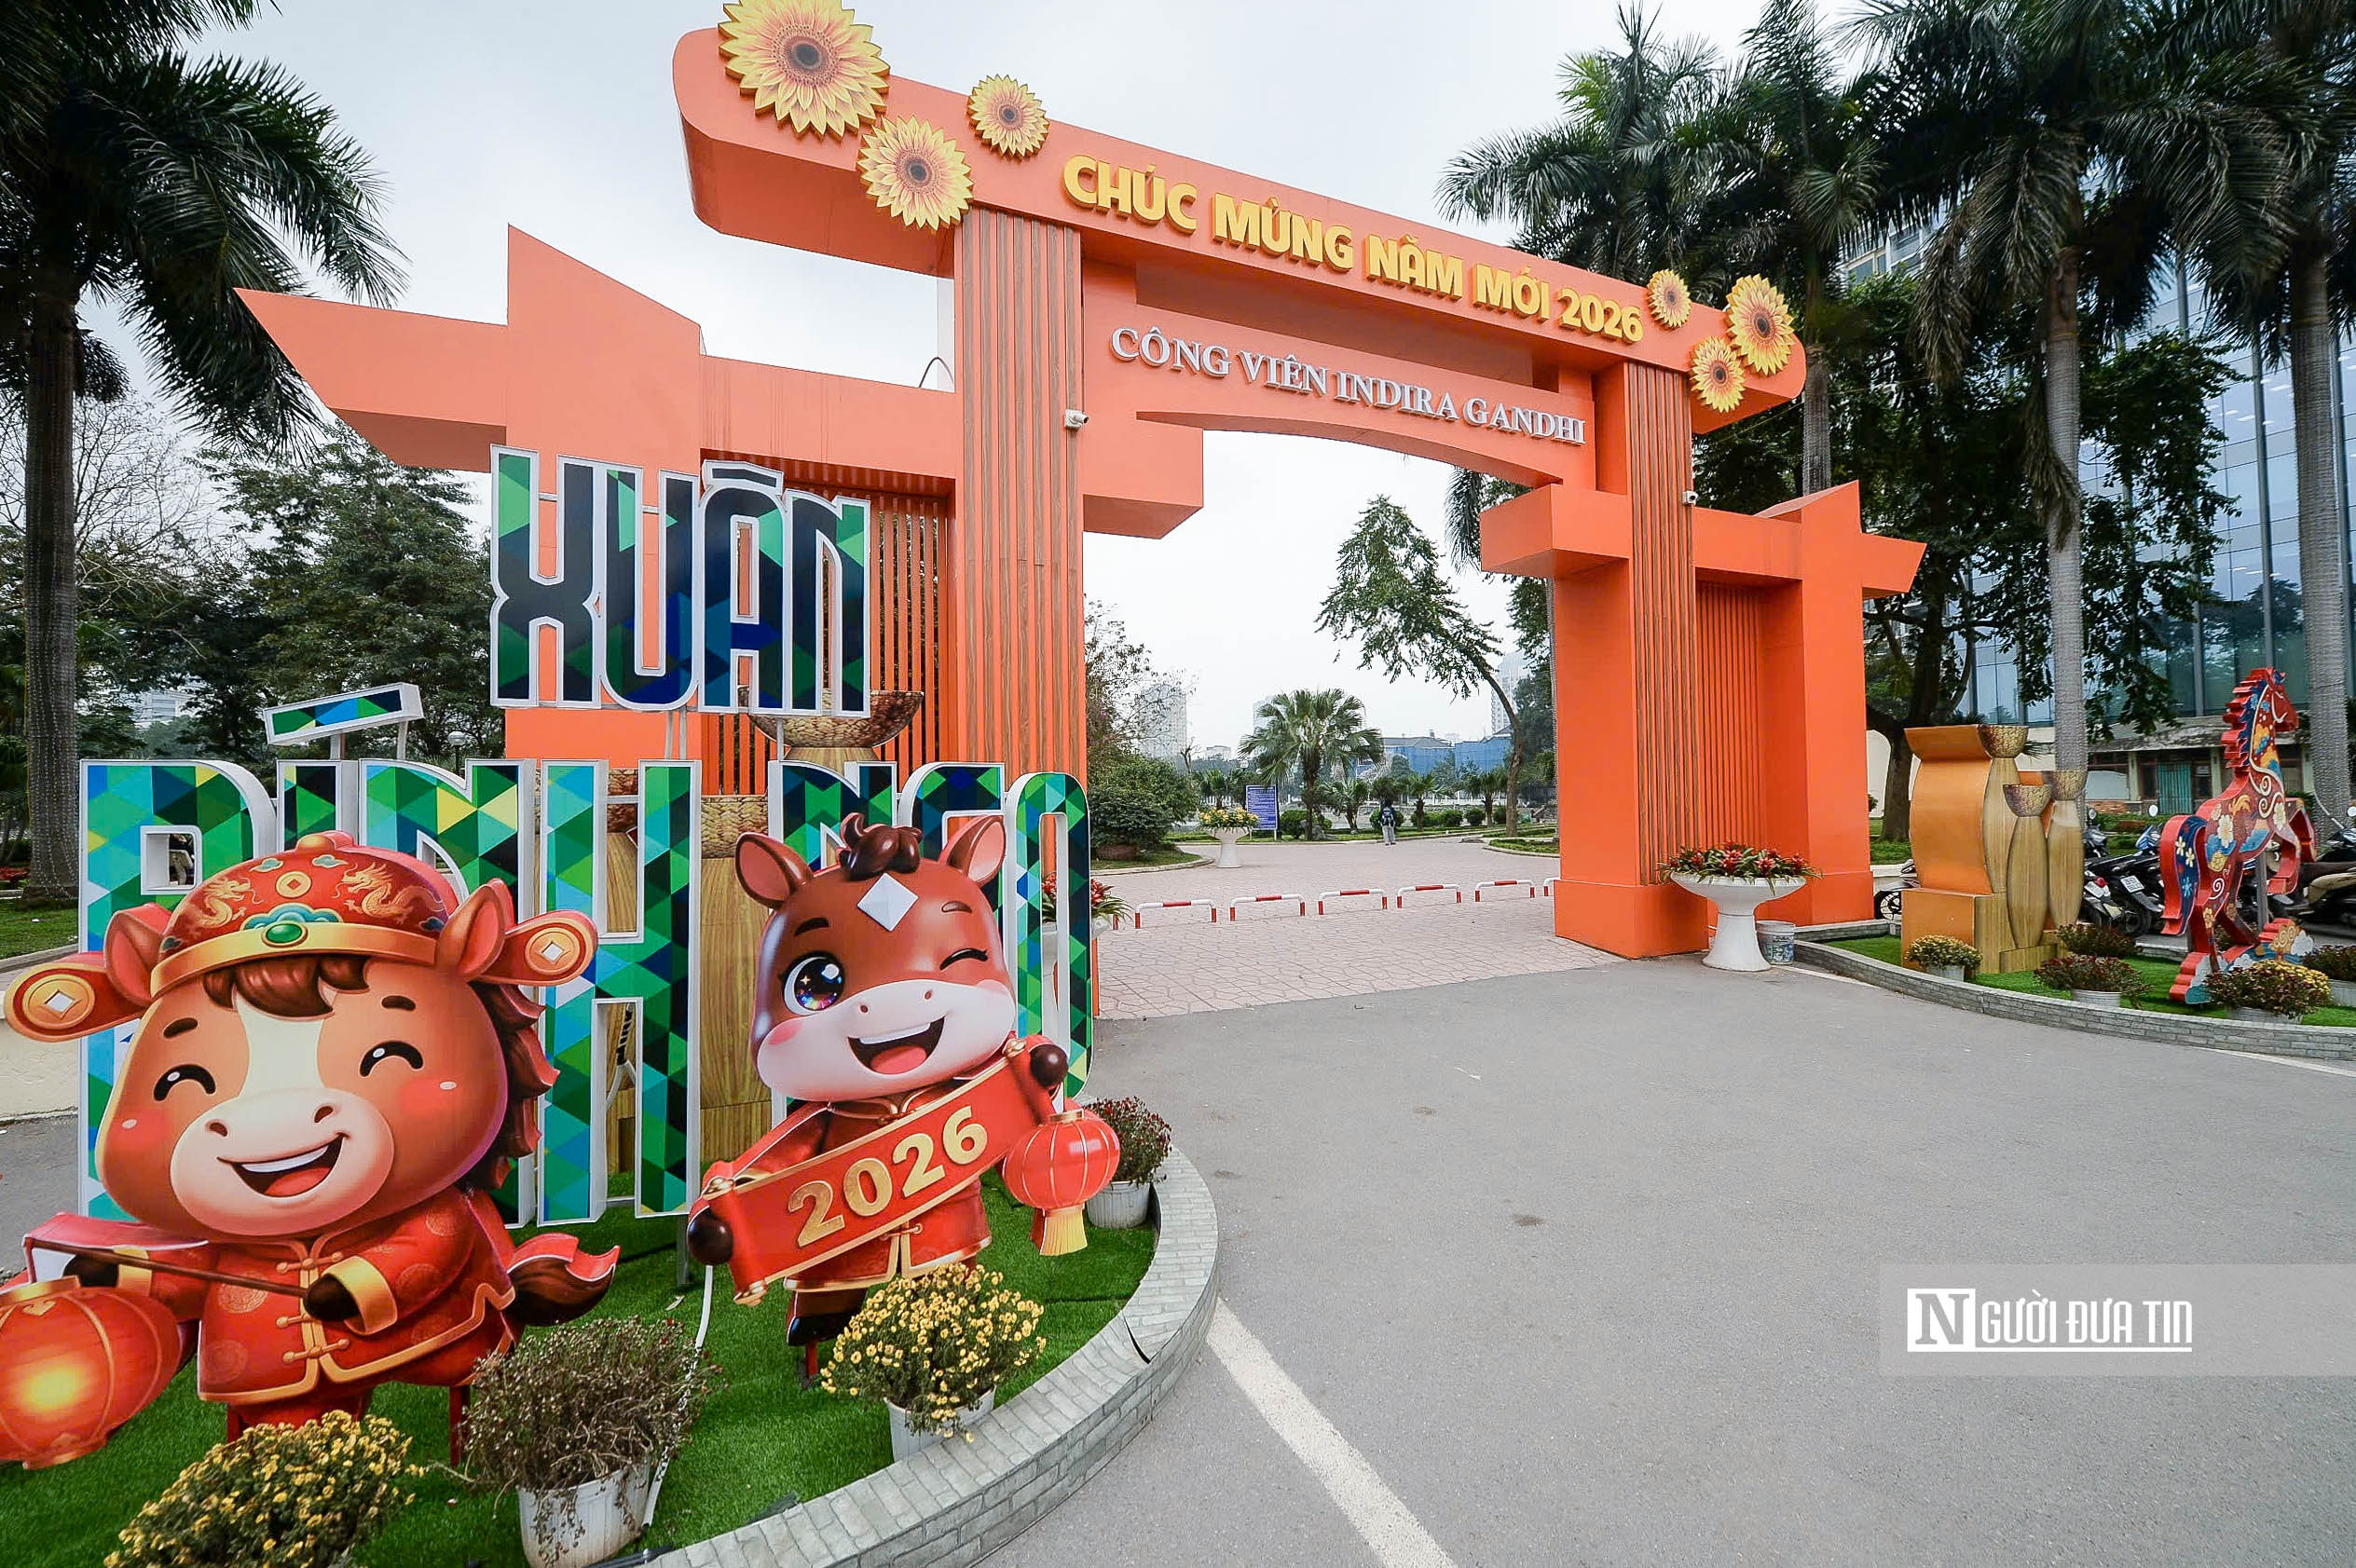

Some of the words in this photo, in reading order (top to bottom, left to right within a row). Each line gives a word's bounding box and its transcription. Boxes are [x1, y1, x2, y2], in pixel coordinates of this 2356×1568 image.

[1062, 154, 1198, 235] CHÚC
[1365, 233, 1463, 300] NĂM
[1472, 265, 1551, 323] MỚI
[1557, 287, 1645, 344] 2026
[1110, 326, 1232, 378] CÔNG
[1238, 349, 1328, 398] VIÊN
[1334, 371, 1459, 420] INDIRA
[1462, 396, 1586, 444] GANDHI
[788, 1105, 988, 1248] 2026
